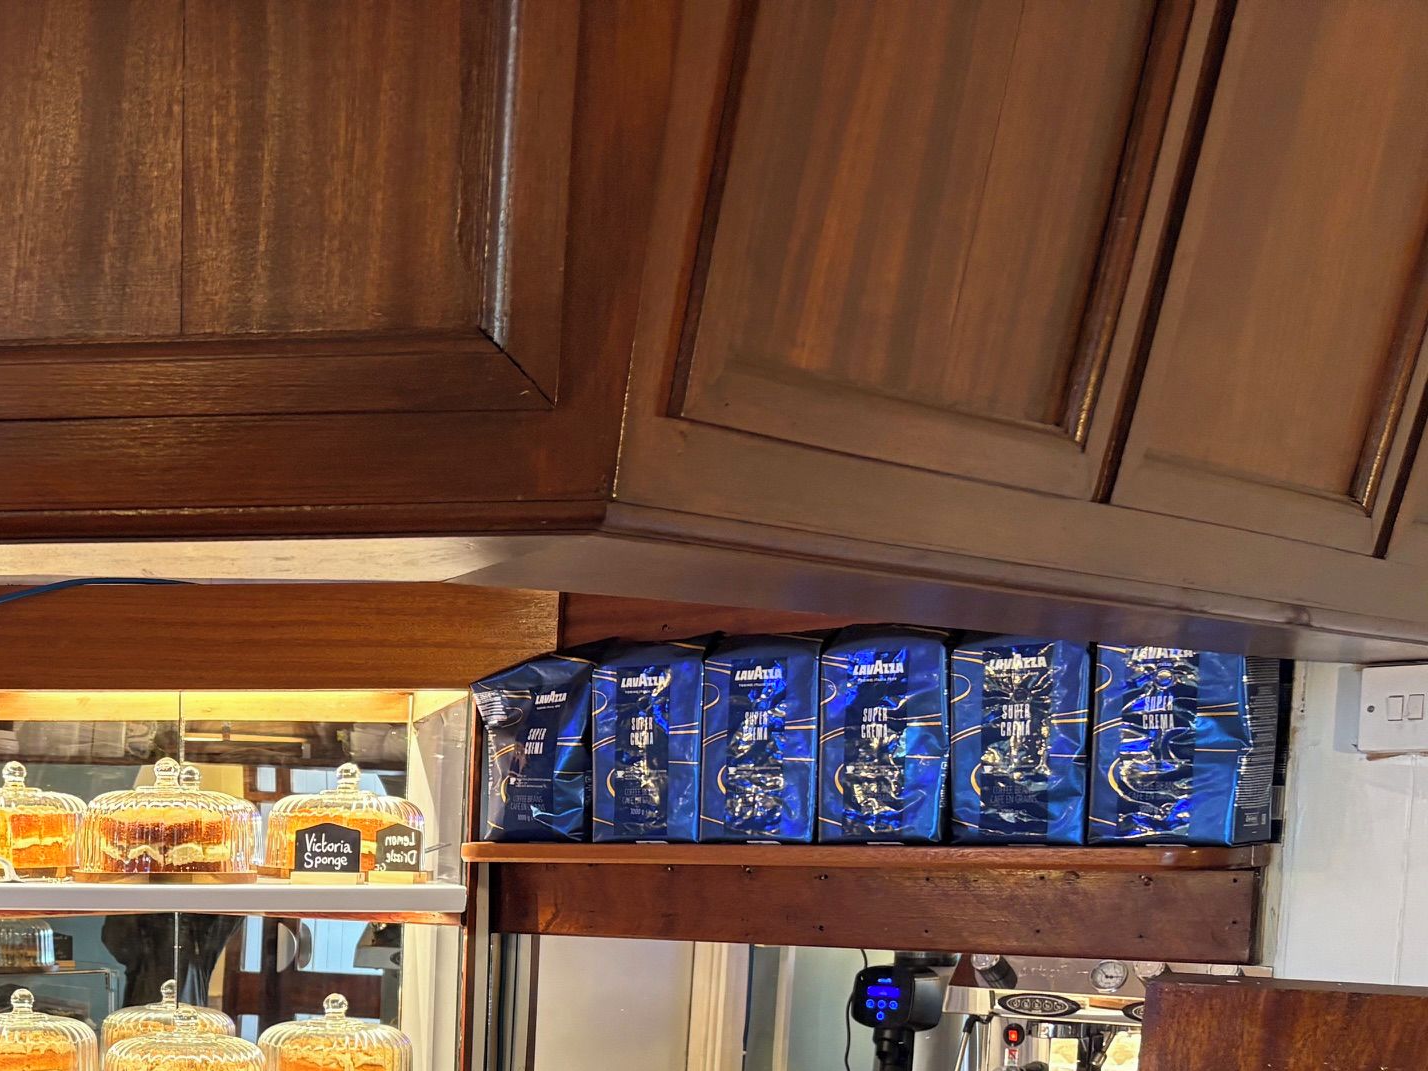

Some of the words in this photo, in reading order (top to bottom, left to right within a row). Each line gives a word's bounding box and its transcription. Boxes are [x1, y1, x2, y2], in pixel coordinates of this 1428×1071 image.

[852, 660, 904, 676] LAVAZZA
[990, 654, 1046, 670] LAVAZZA
[735, 666, 782, 681] LAVAZZA
[535, 690, 567, 704] LAVAZZA
[862, 708, 888, 722] SUPER
[1142, 714, 1174, 730] CREMA
[528, 728, 546, 740] SUPER
[861, 724, 888, 739] CREMA
[524, 742, 544, 754] CREMA
[305, 833, 352, 853] Victoria
[304, 852, 348, 870] Sponge
